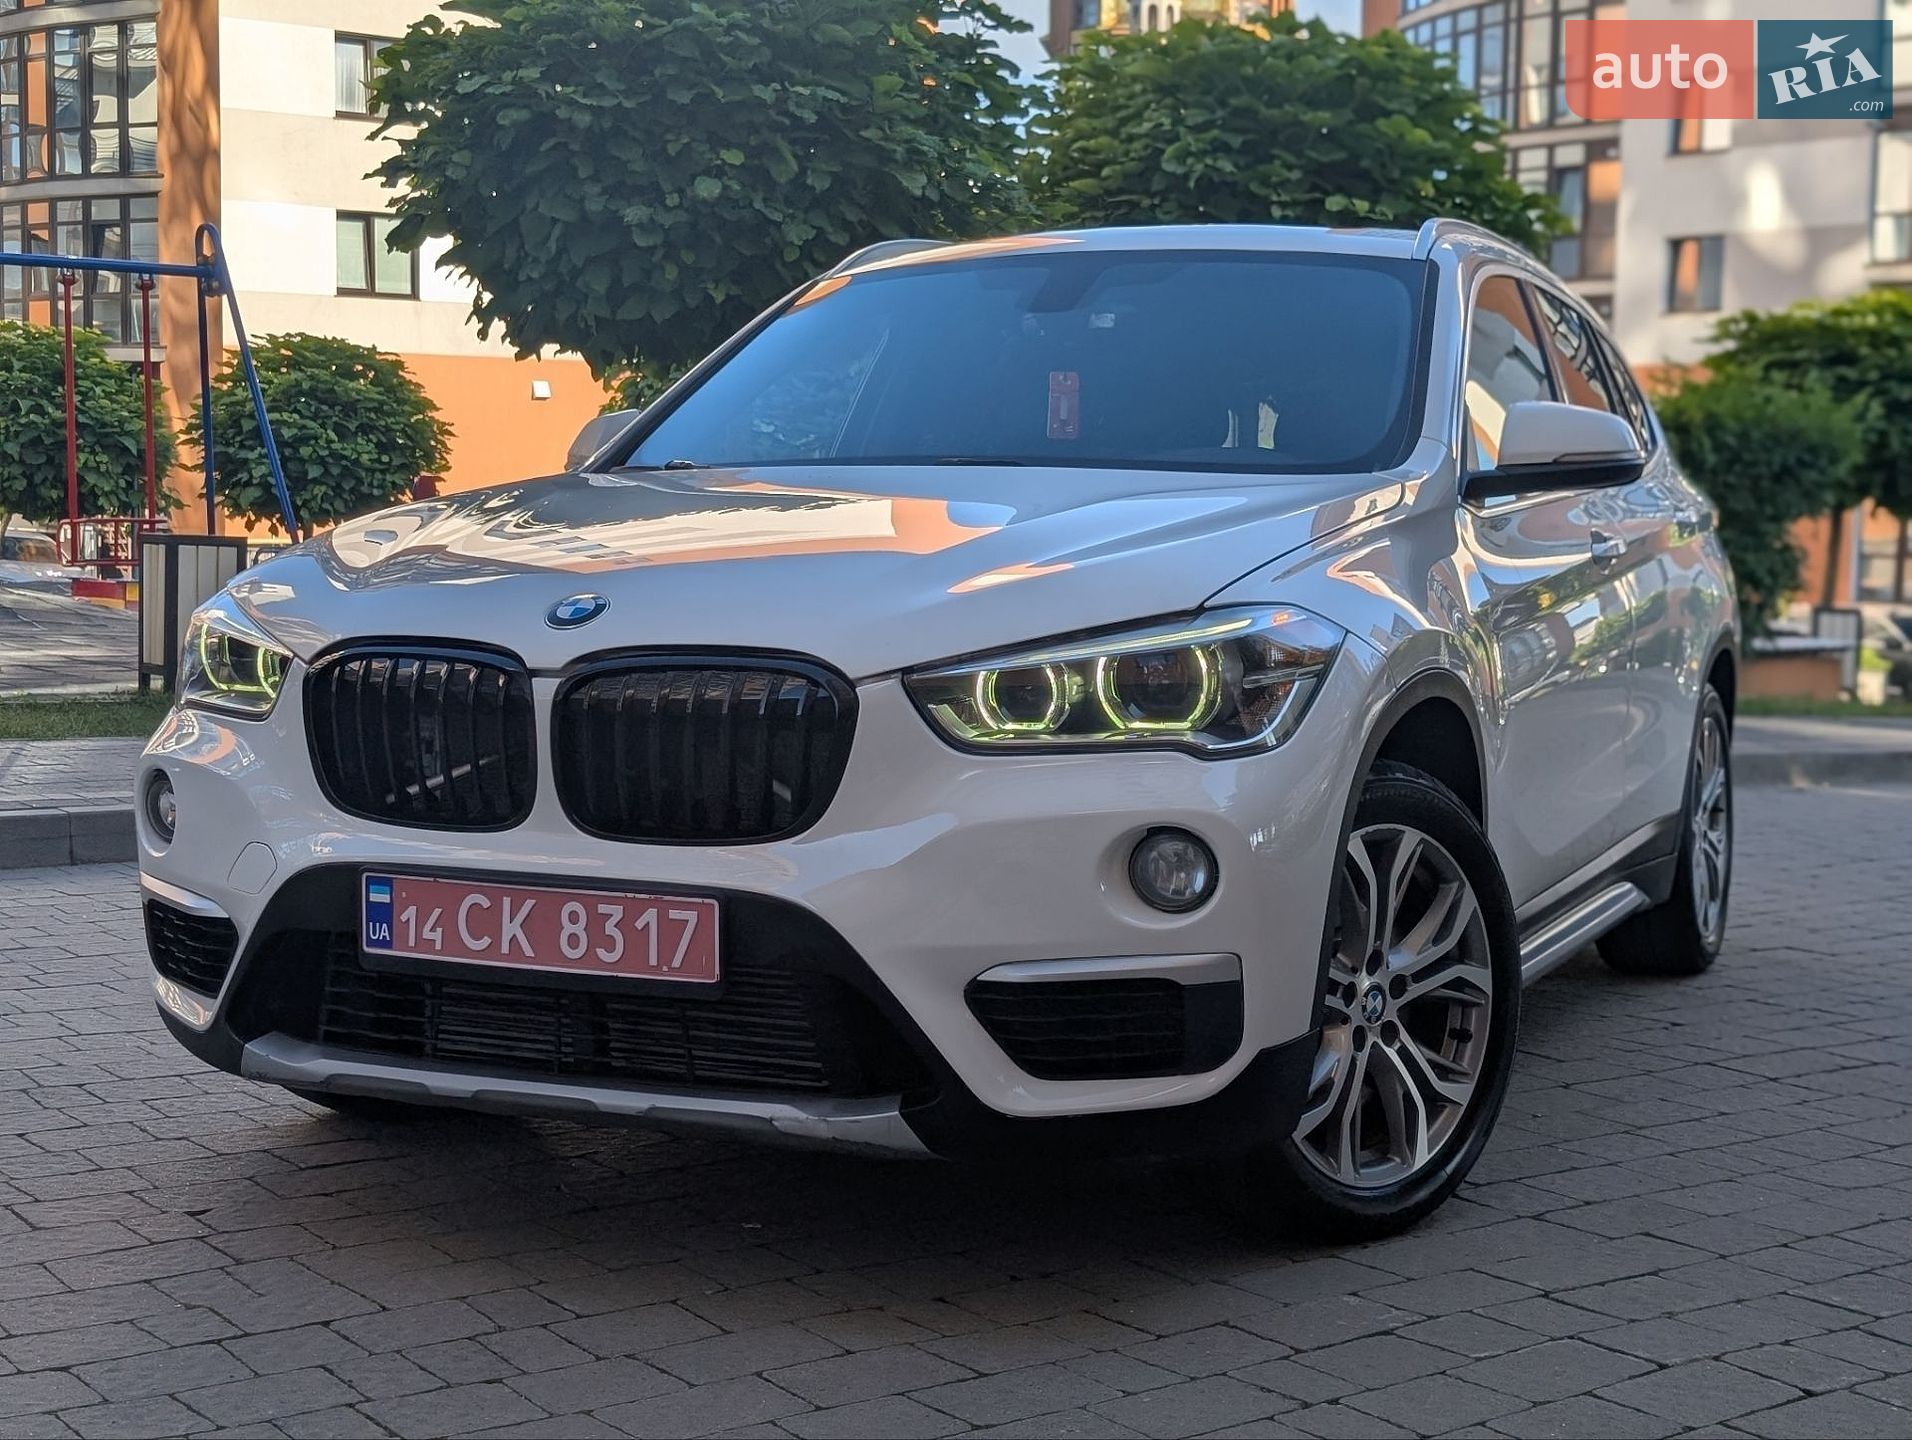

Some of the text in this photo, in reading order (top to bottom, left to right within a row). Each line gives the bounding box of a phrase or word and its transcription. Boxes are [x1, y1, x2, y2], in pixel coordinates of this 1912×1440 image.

[369, 921, 390, 941] UA
[400, 893, 698, 968] 14 CK 8317
